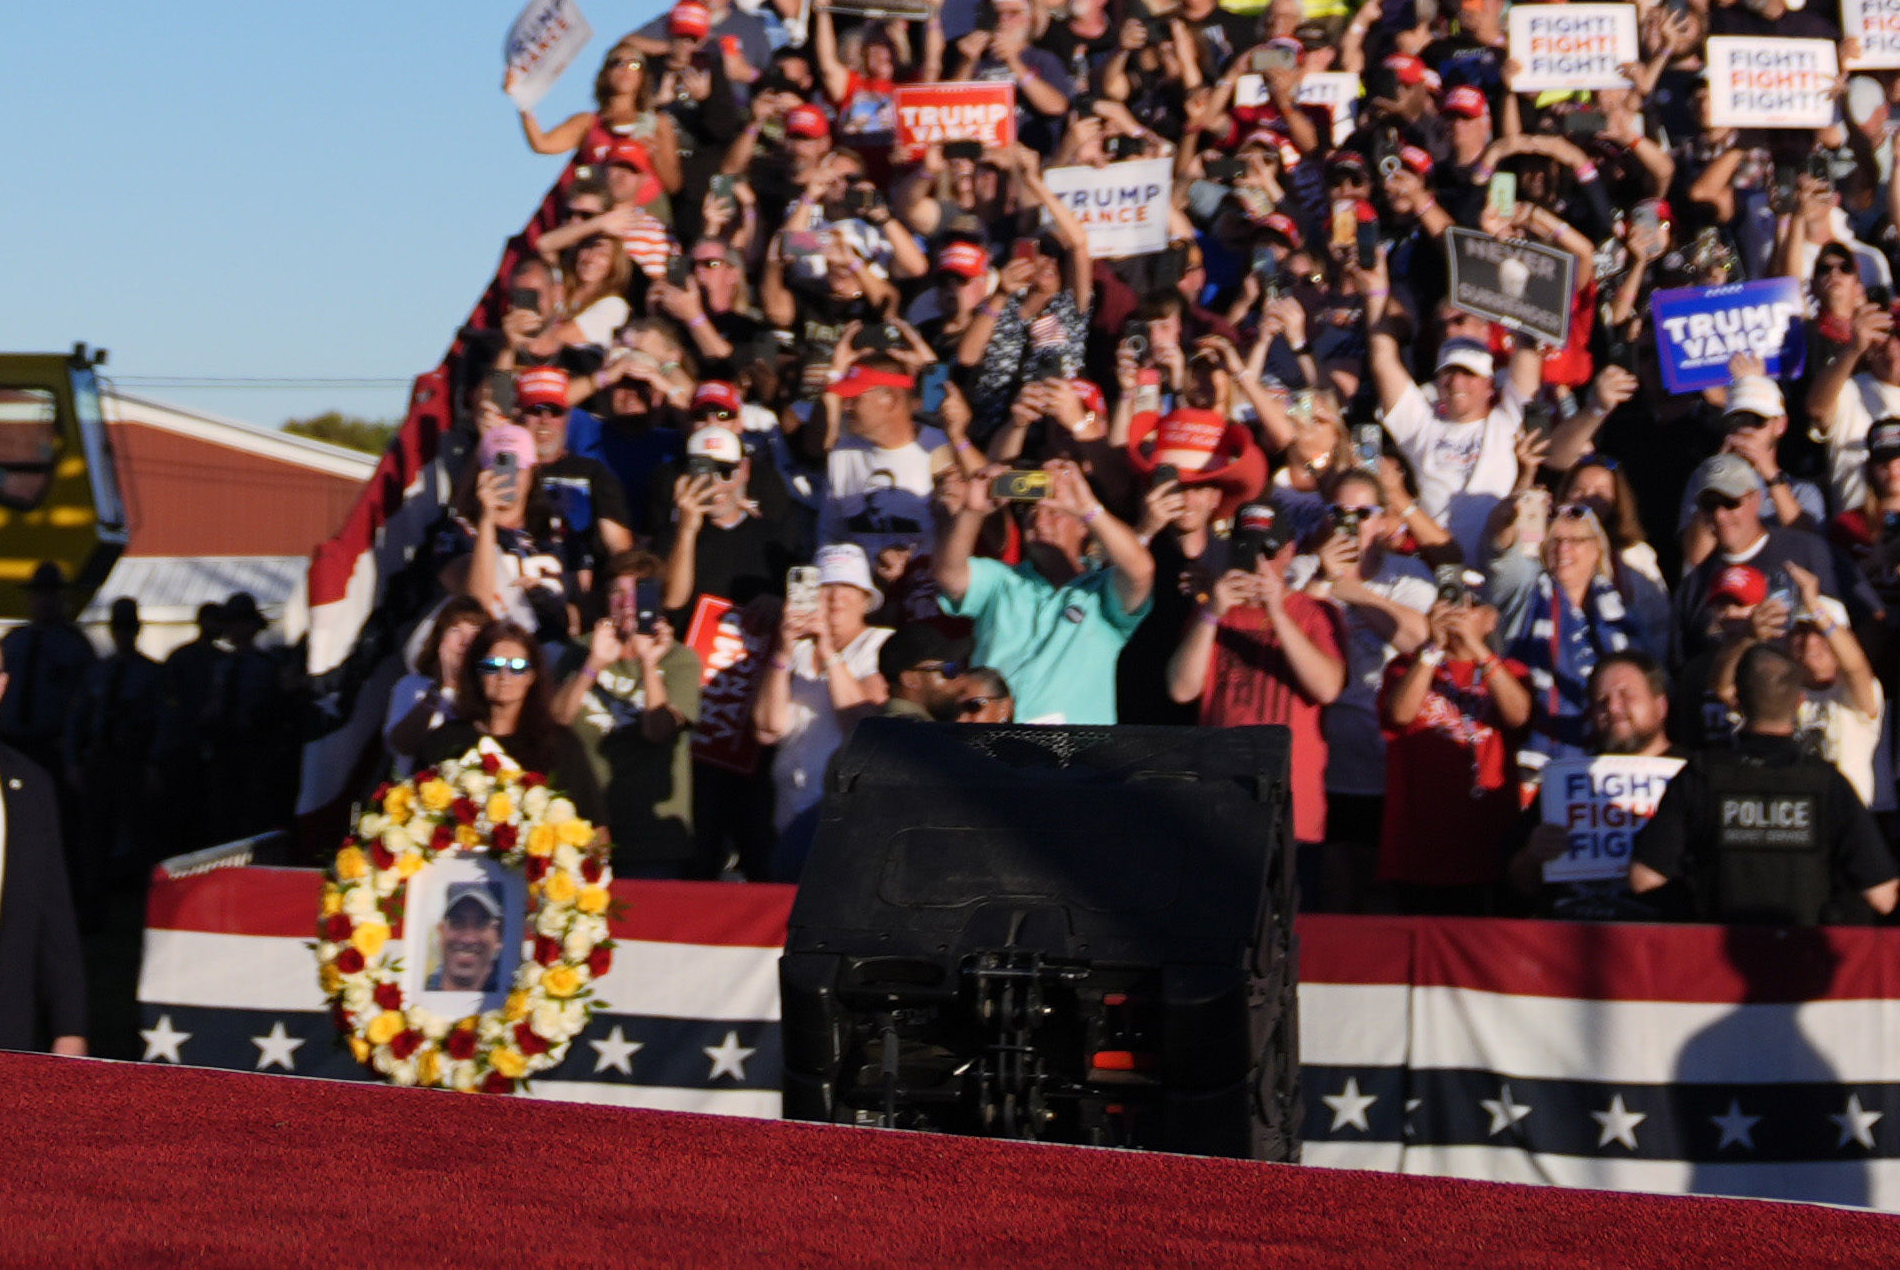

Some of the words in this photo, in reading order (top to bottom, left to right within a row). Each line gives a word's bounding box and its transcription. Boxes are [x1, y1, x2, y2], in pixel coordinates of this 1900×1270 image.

[1530, 15, 1616, 36] FIGHT!
[1530, 35, 1618, 56] FIGHT!
[1532, 54, 1617, 75] FIGHT!
[1730, 49, 1817, 68] FIGHT!
[1730, 69, 1820, 90] FIGHT!
[1732, 90, 1819, 112] FIGHT!
[899, 104, 1007, 126] TRUMP
[911, 123, 997, 143] VANCE
[1071, 205, 1148, 224] ANCE
[1567, 800, 1656, 830] FIGH
[1723, 799, 1810, 828] POLICE
[1570, 830, 1630, 861] FIG
